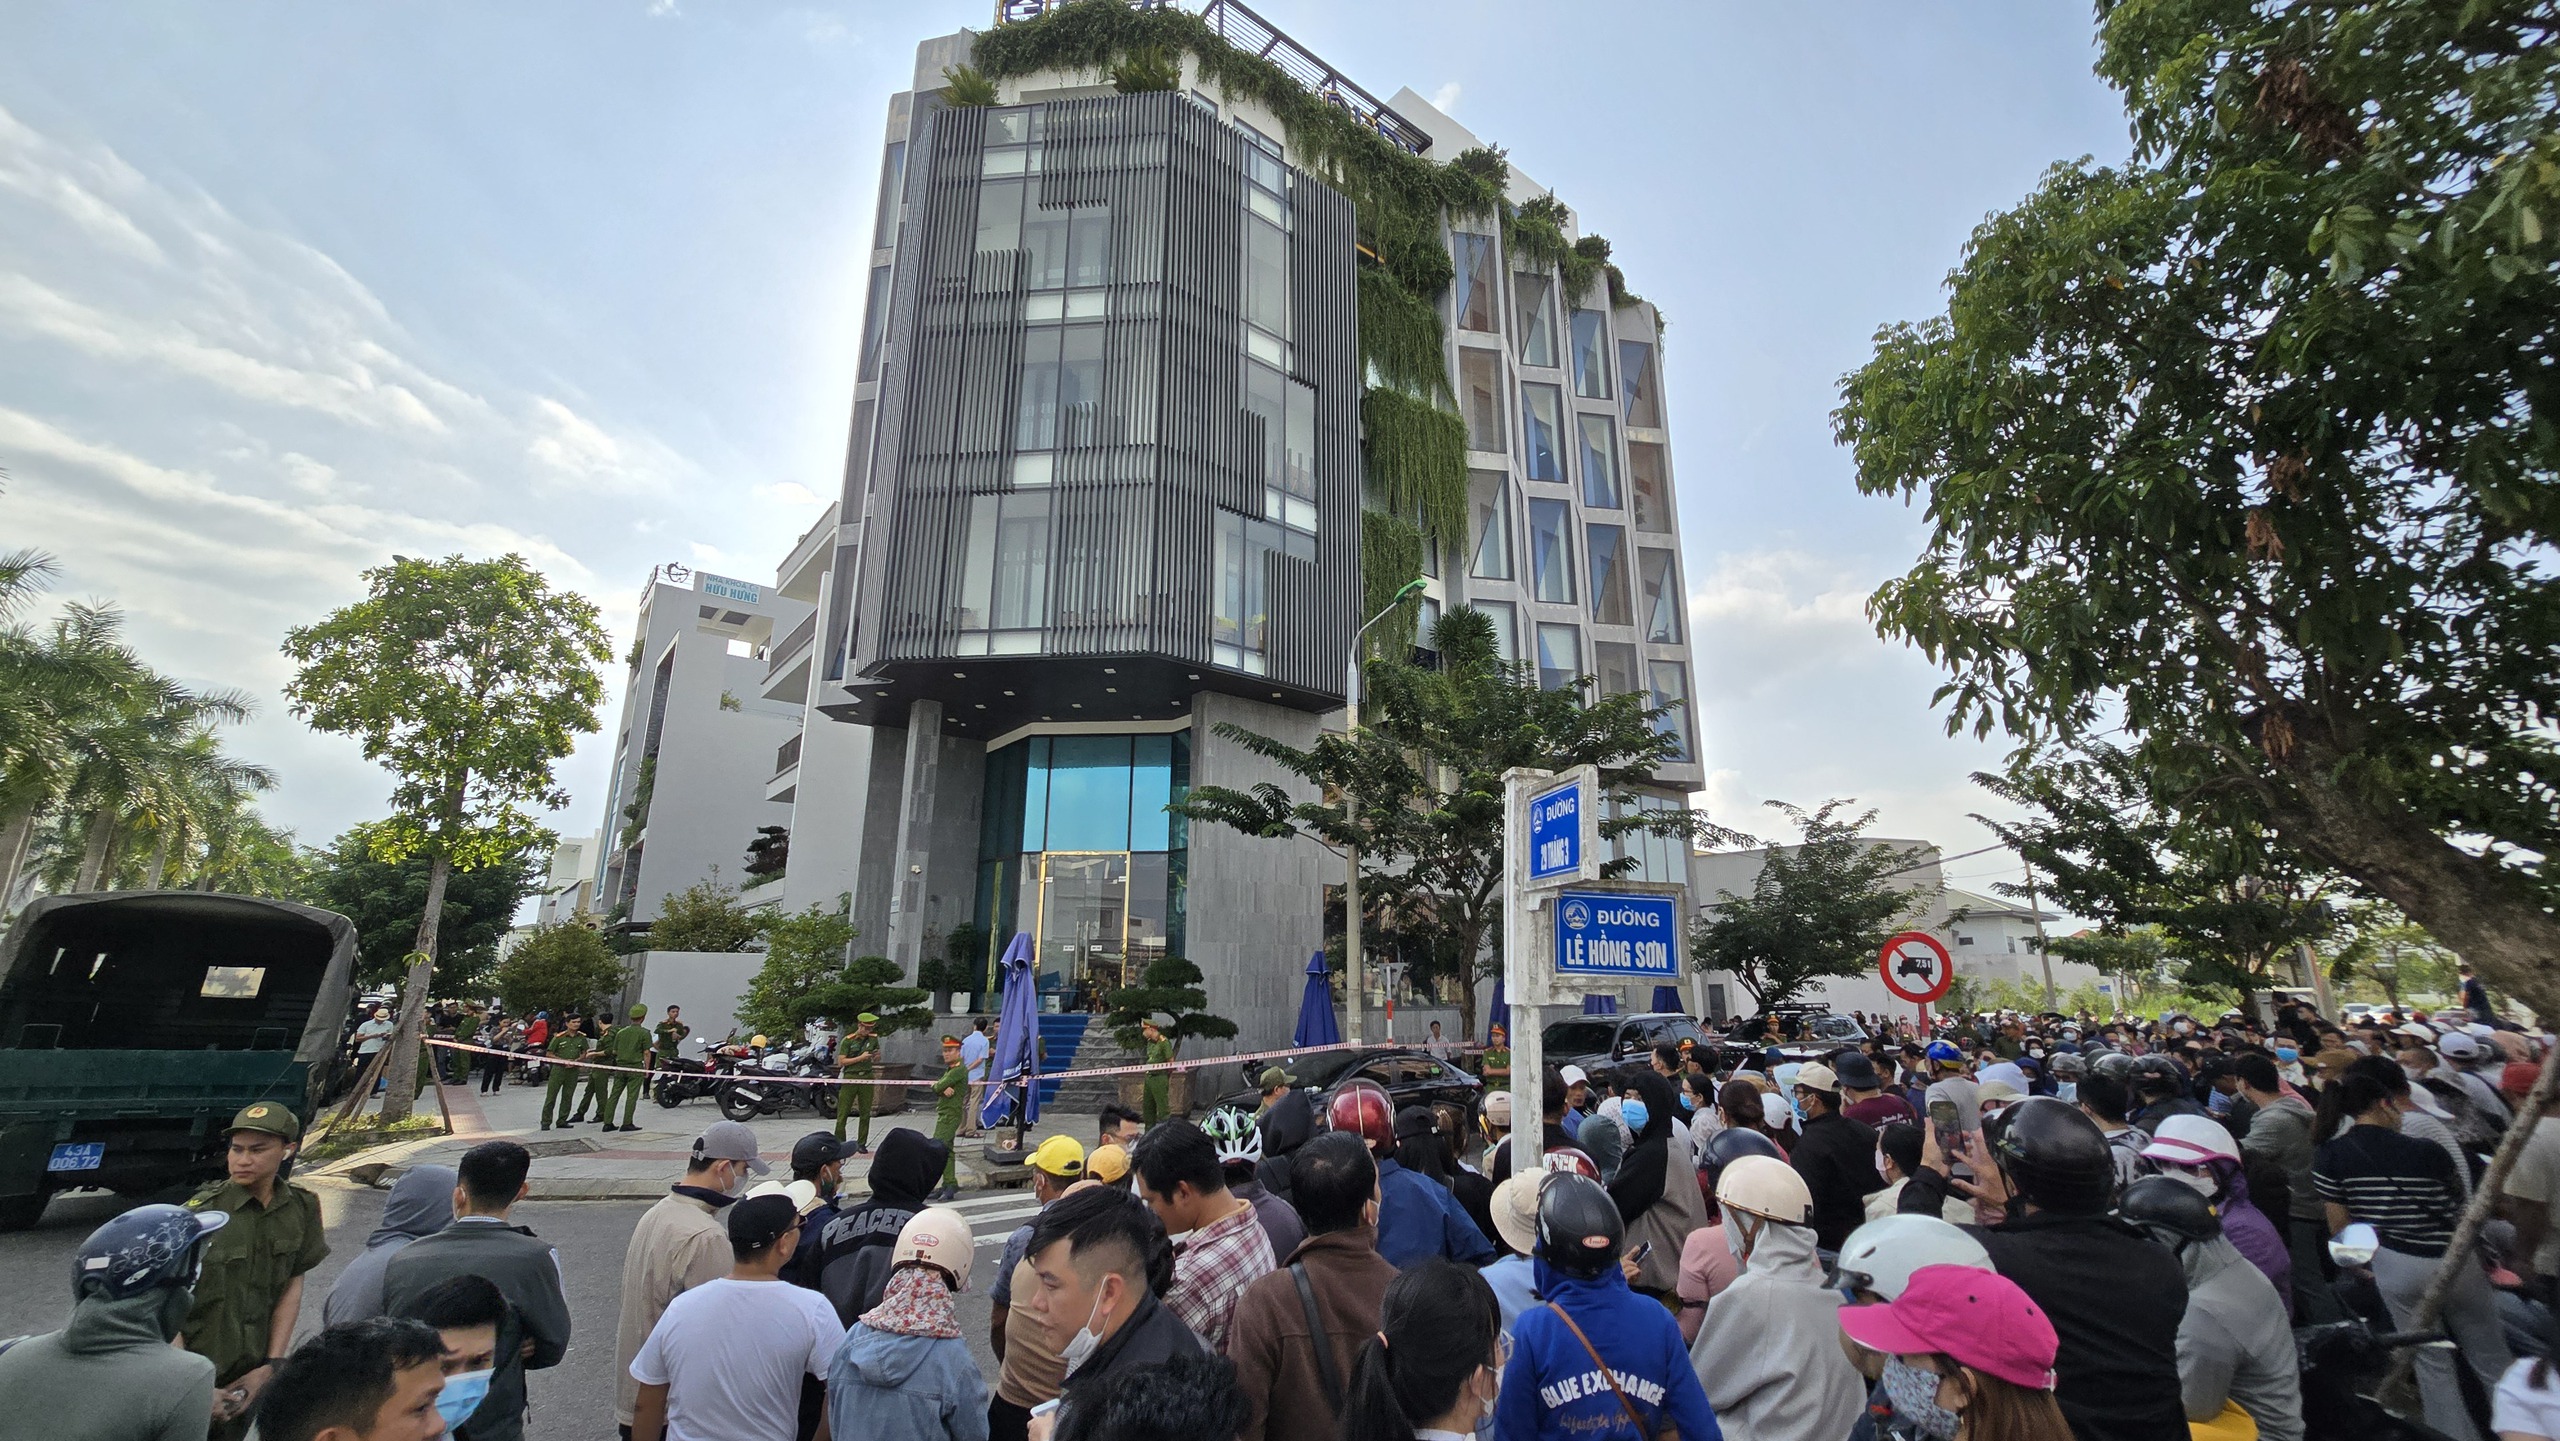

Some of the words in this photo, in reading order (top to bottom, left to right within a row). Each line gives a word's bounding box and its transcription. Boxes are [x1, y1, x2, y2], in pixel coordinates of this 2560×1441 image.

[707, 574, 723, 584] NHA
[725, 578, 747, 589] KHOA
[729, 588, 758, 603] HƯNG
[1546, 797, 1575, 822] ĐƯỜNG
[1547, 834, 1565, 869] THÁNG
[1564, 837, 1569, 866] 3
[1597, 905, 1660, 928] ĐƯỜNG
[1566, 933, 1585, 965] LÊ
[1588, 929, 1632, 967] HỒNG
[1635, 940, 1667, 969] SƠN
[50, 1155, 99, 1169] 006.72
[64, 1144, 91, 1157] 43A
[1540, 1376, 1582, 1409] BLUE
[1581, 1368, 1666, 1407] EXCHANGE
